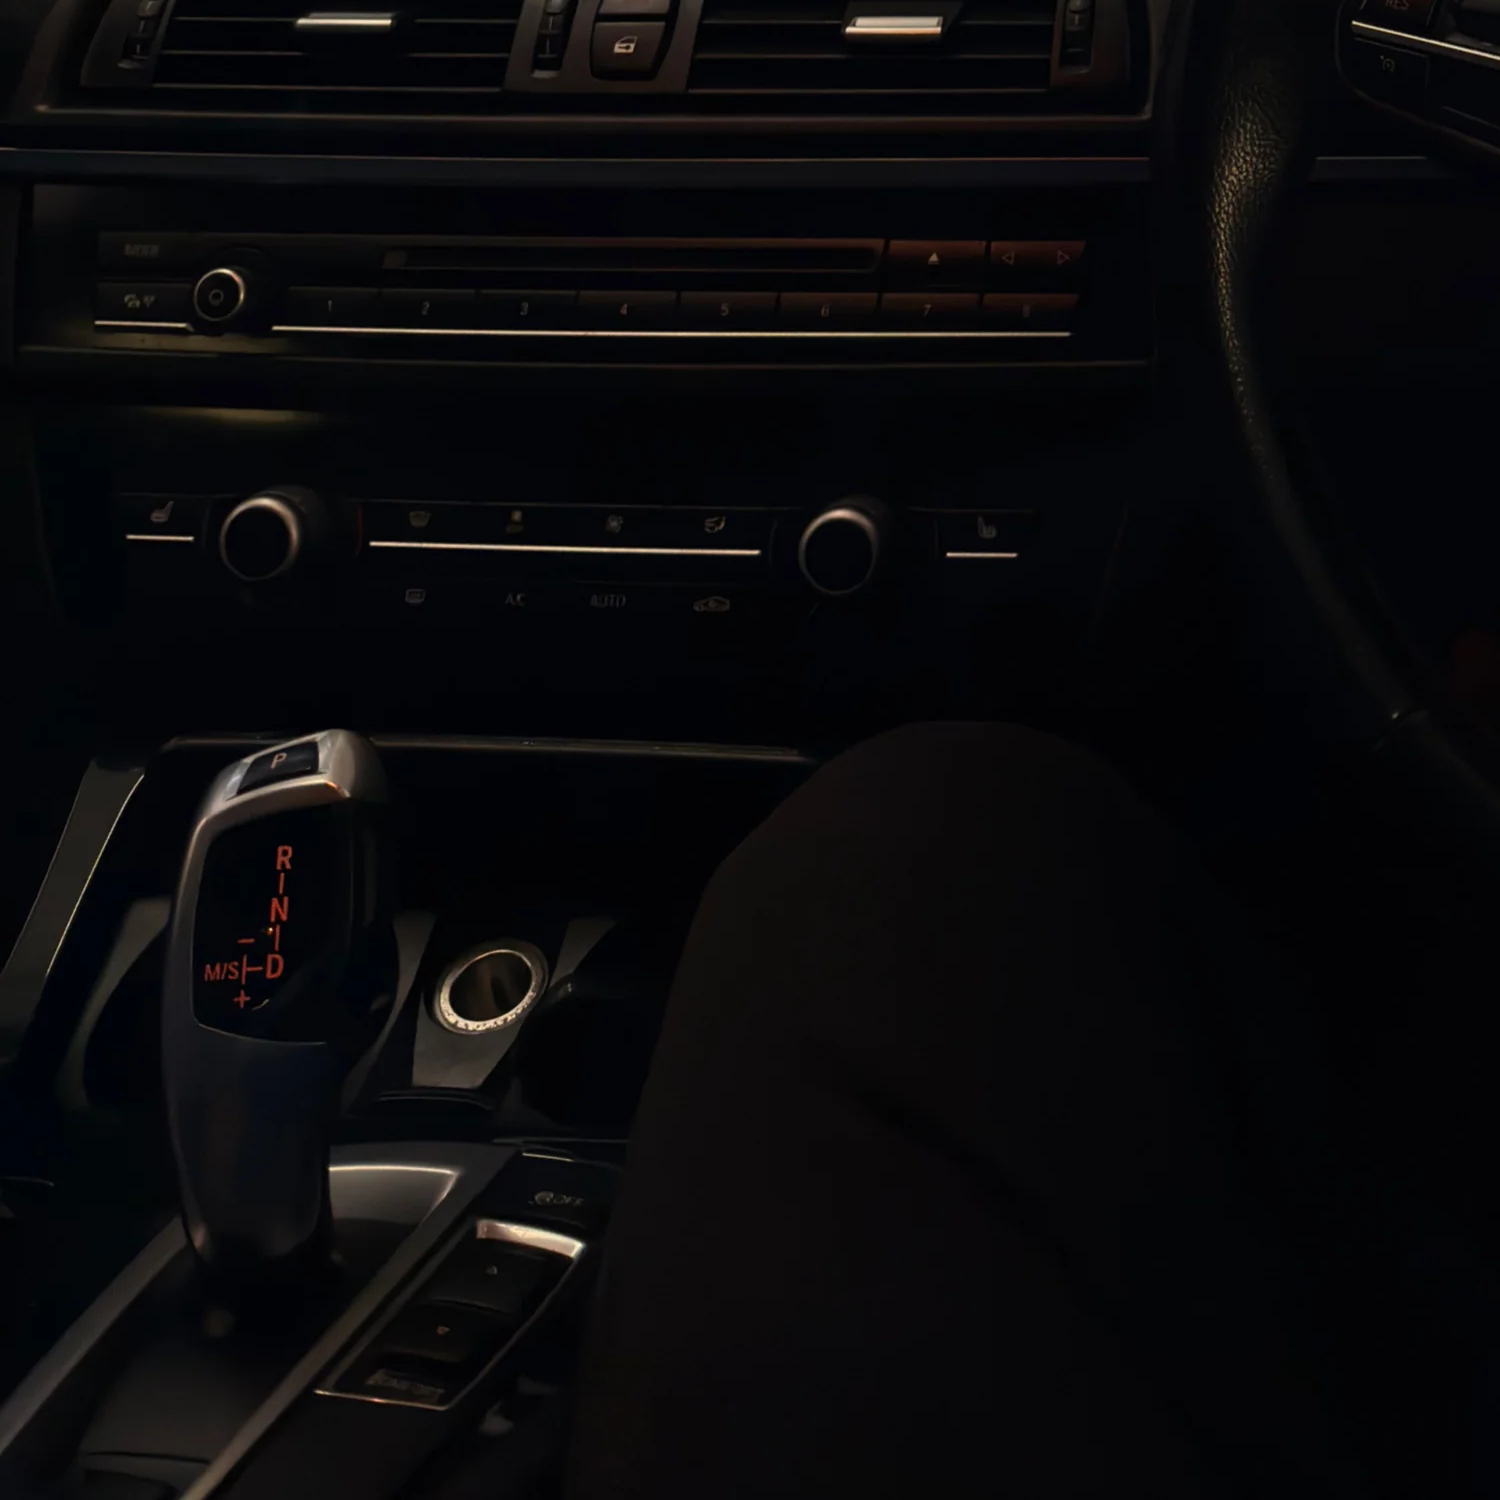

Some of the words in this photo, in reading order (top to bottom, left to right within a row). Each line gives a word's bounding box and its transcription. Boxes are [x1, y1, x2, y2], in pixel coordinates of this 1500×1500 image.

[421, 301, 430, 315] 2
[520, 302, 529, 316] 3
[620, 303, 628, 316] 4
[720, 303, 730, 317] 5
[923, 304, 932, 318] 7
[589, 593, 627, 608] AUTO
[270, 752, 287, 769] P
[275, 844, 293, 871] R
[269, 895, 290, 923] N
[204, 961, 239, 983] M/S
[264, 953, 285, 980] D
